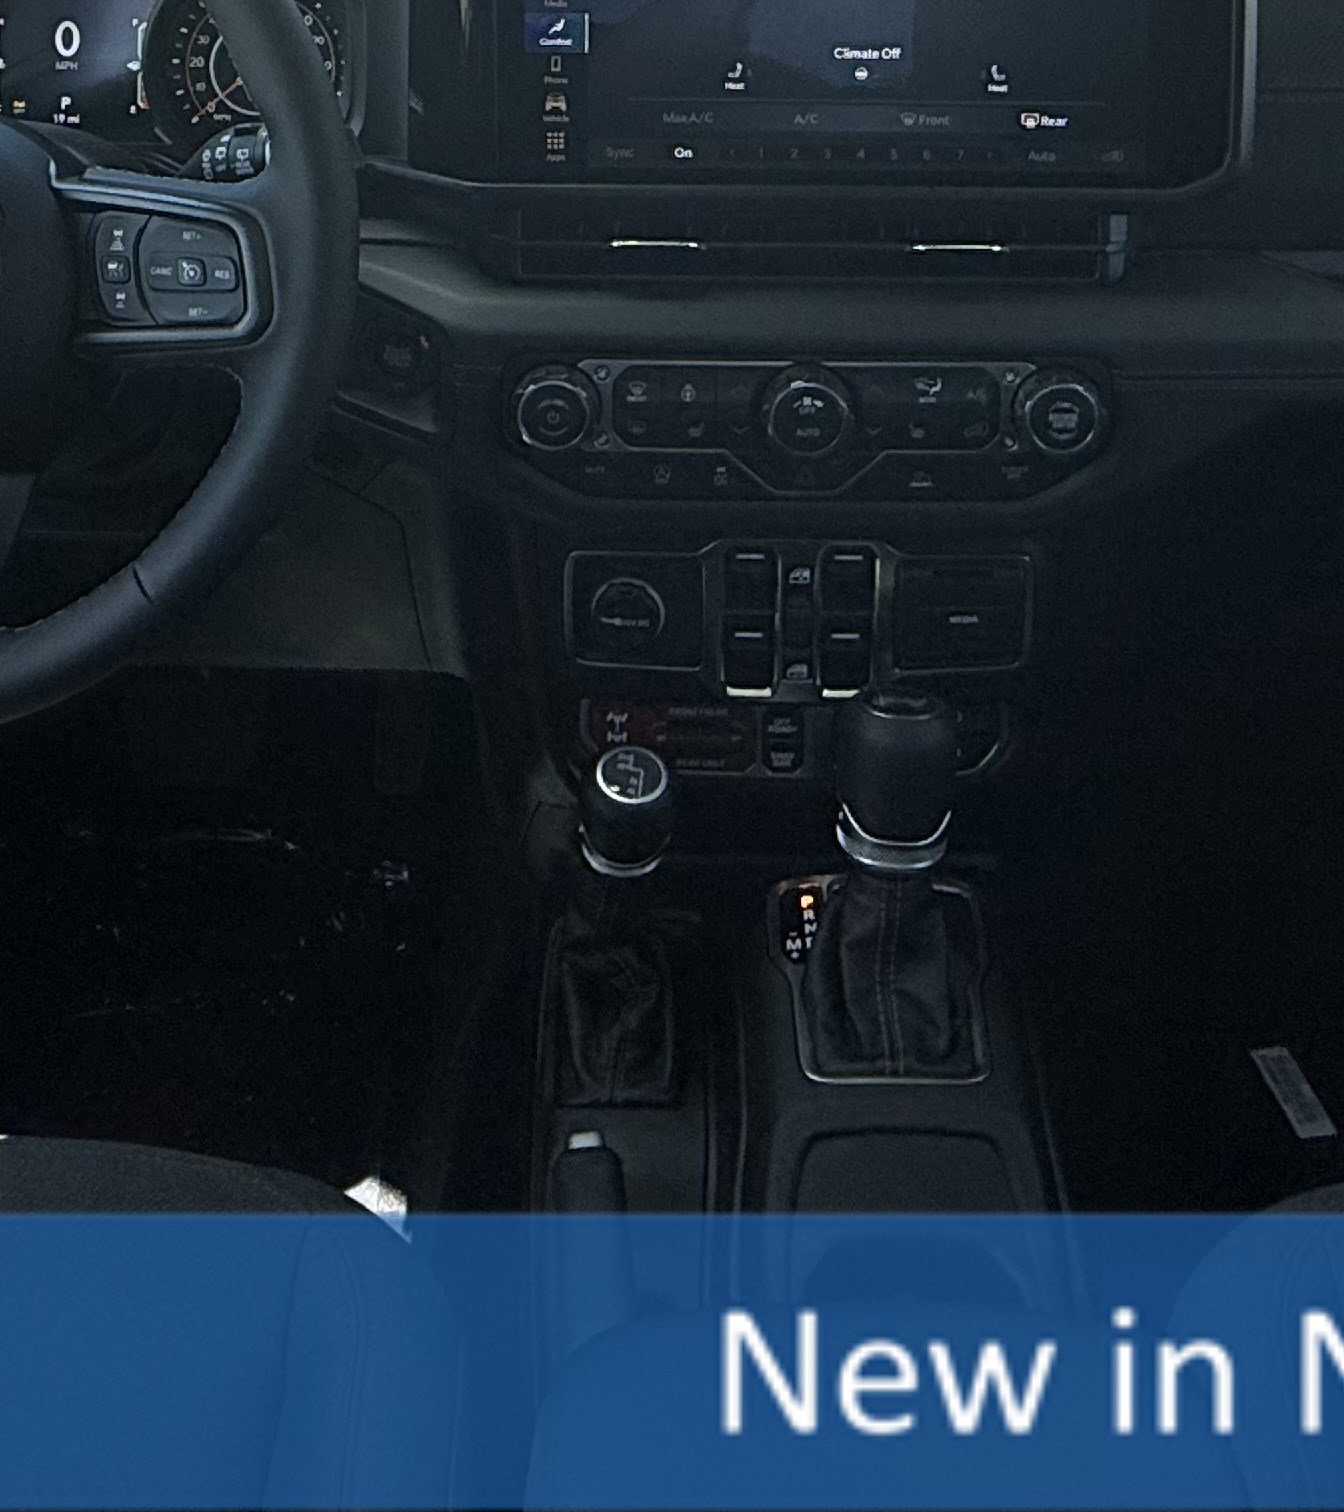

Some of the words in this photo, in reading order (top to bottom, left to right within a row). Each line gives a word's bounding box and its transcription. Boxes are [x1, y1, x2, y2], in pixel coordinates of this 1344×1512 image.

[54, 20, 81, 58] 0
[834, 46, 880, 60] Climate
[881, 45, 902, 60] Off
[189, 56, 206, 68] 20
[60, 96, 72, 110] P
[1040, 115, 1069, 128] Rear
[674, 146, 694, 159] On
[804, 920, 818, 935] N
[785, 936, 802, 951] M
